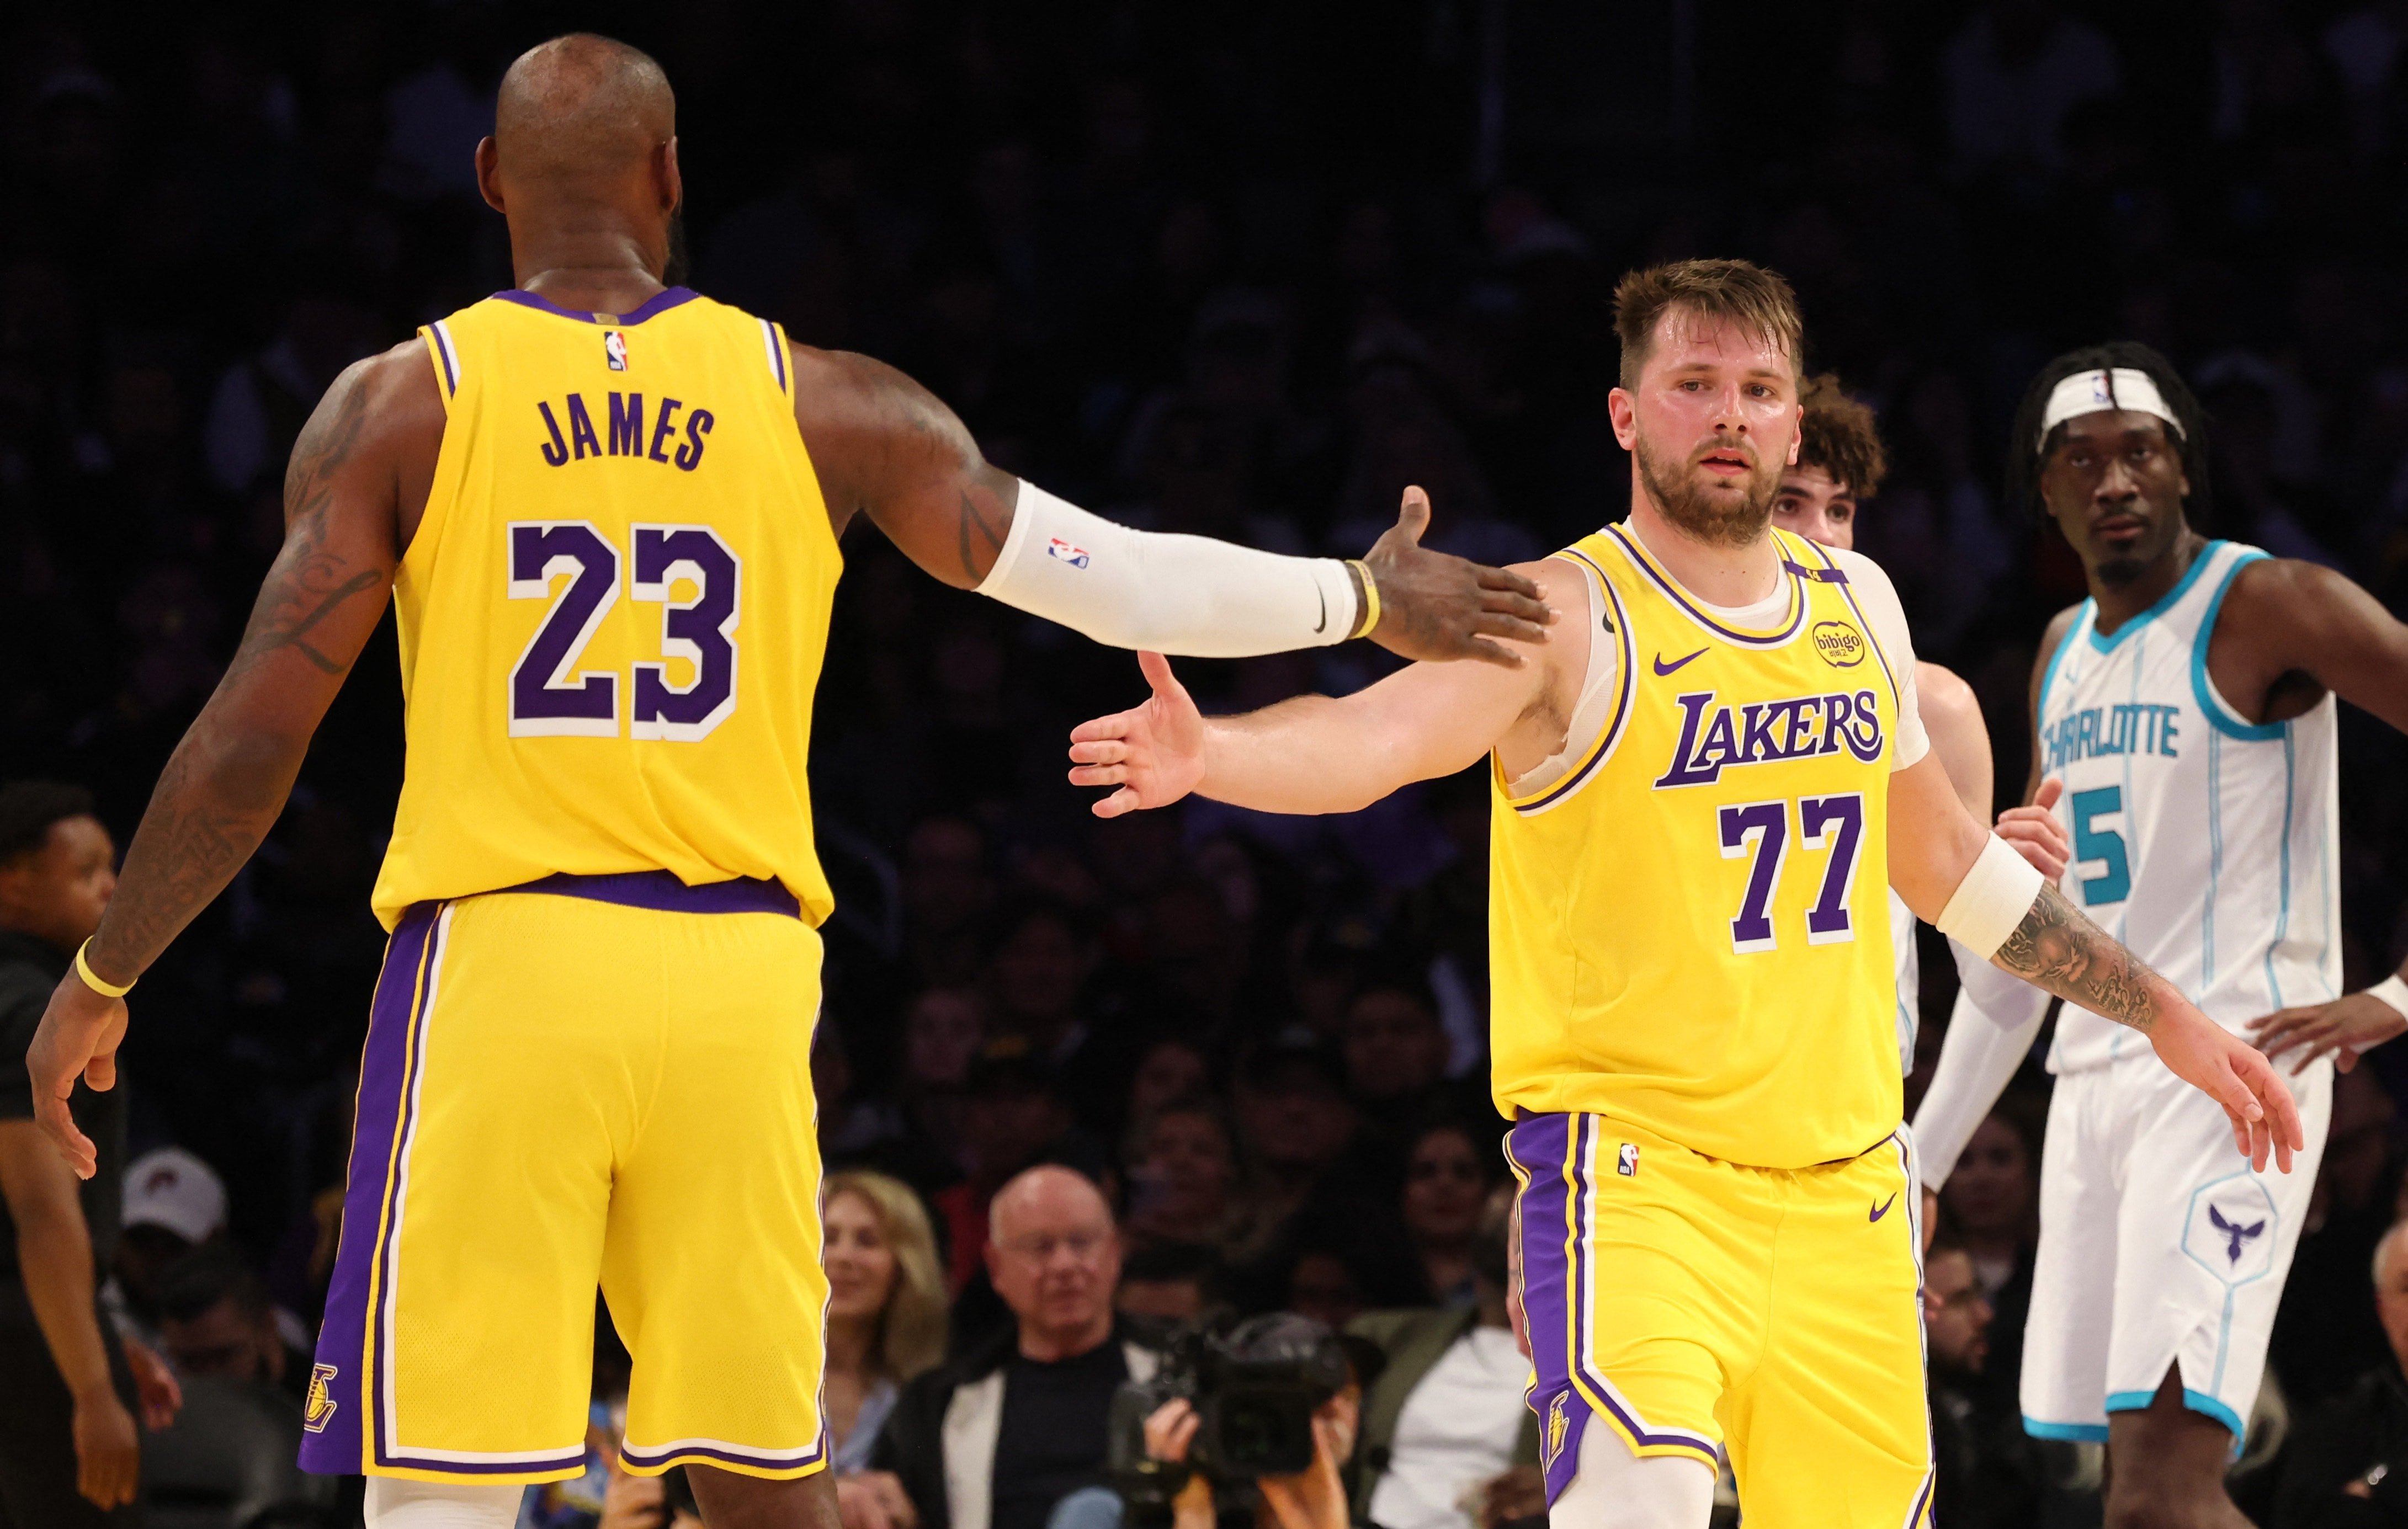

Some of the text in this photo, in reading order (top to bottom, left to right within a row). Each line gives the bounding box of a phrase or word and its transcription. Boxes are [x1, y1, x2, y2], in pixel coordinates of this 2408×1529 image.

[538, 391, 715, 471] JAMES
[507, 520, 742, 743] 23
[1816, 633, 1859, 652] bibigo
[1651, 690, 1883, 791] LAKERS
[1716, 791, 1865, 955] 77
[2072, 786, 2131, 907] 5
